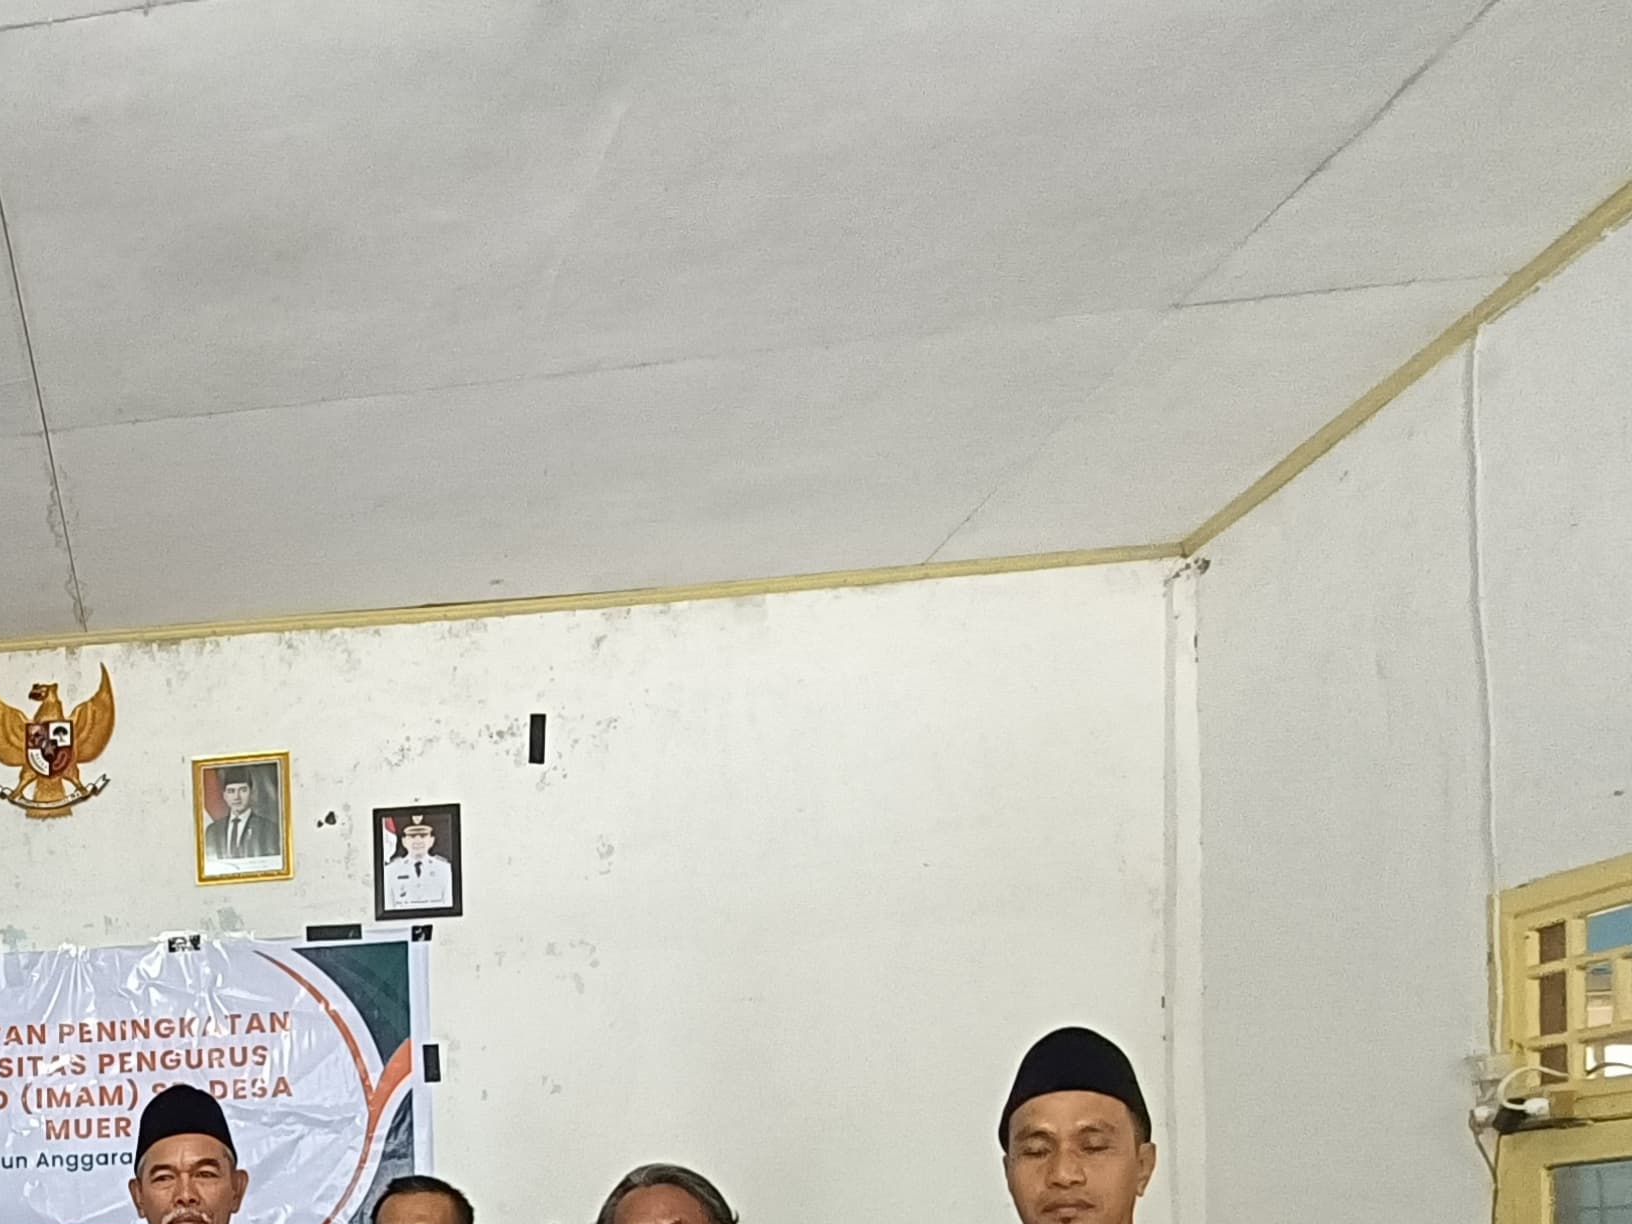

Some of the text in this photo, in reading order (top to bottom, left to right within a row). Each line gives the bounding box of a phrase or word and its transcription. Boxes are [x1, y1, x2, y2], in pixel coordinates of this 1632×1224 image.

[98, 1045, 269, 1075] PENGURUS
[21, 1078, 138, 1115] (IMAM)
[209, 1076, 293, 1101] DESA
[45, 1117, 133, 1141] MUER
[36, 1150, 133, 1173] Anggara
